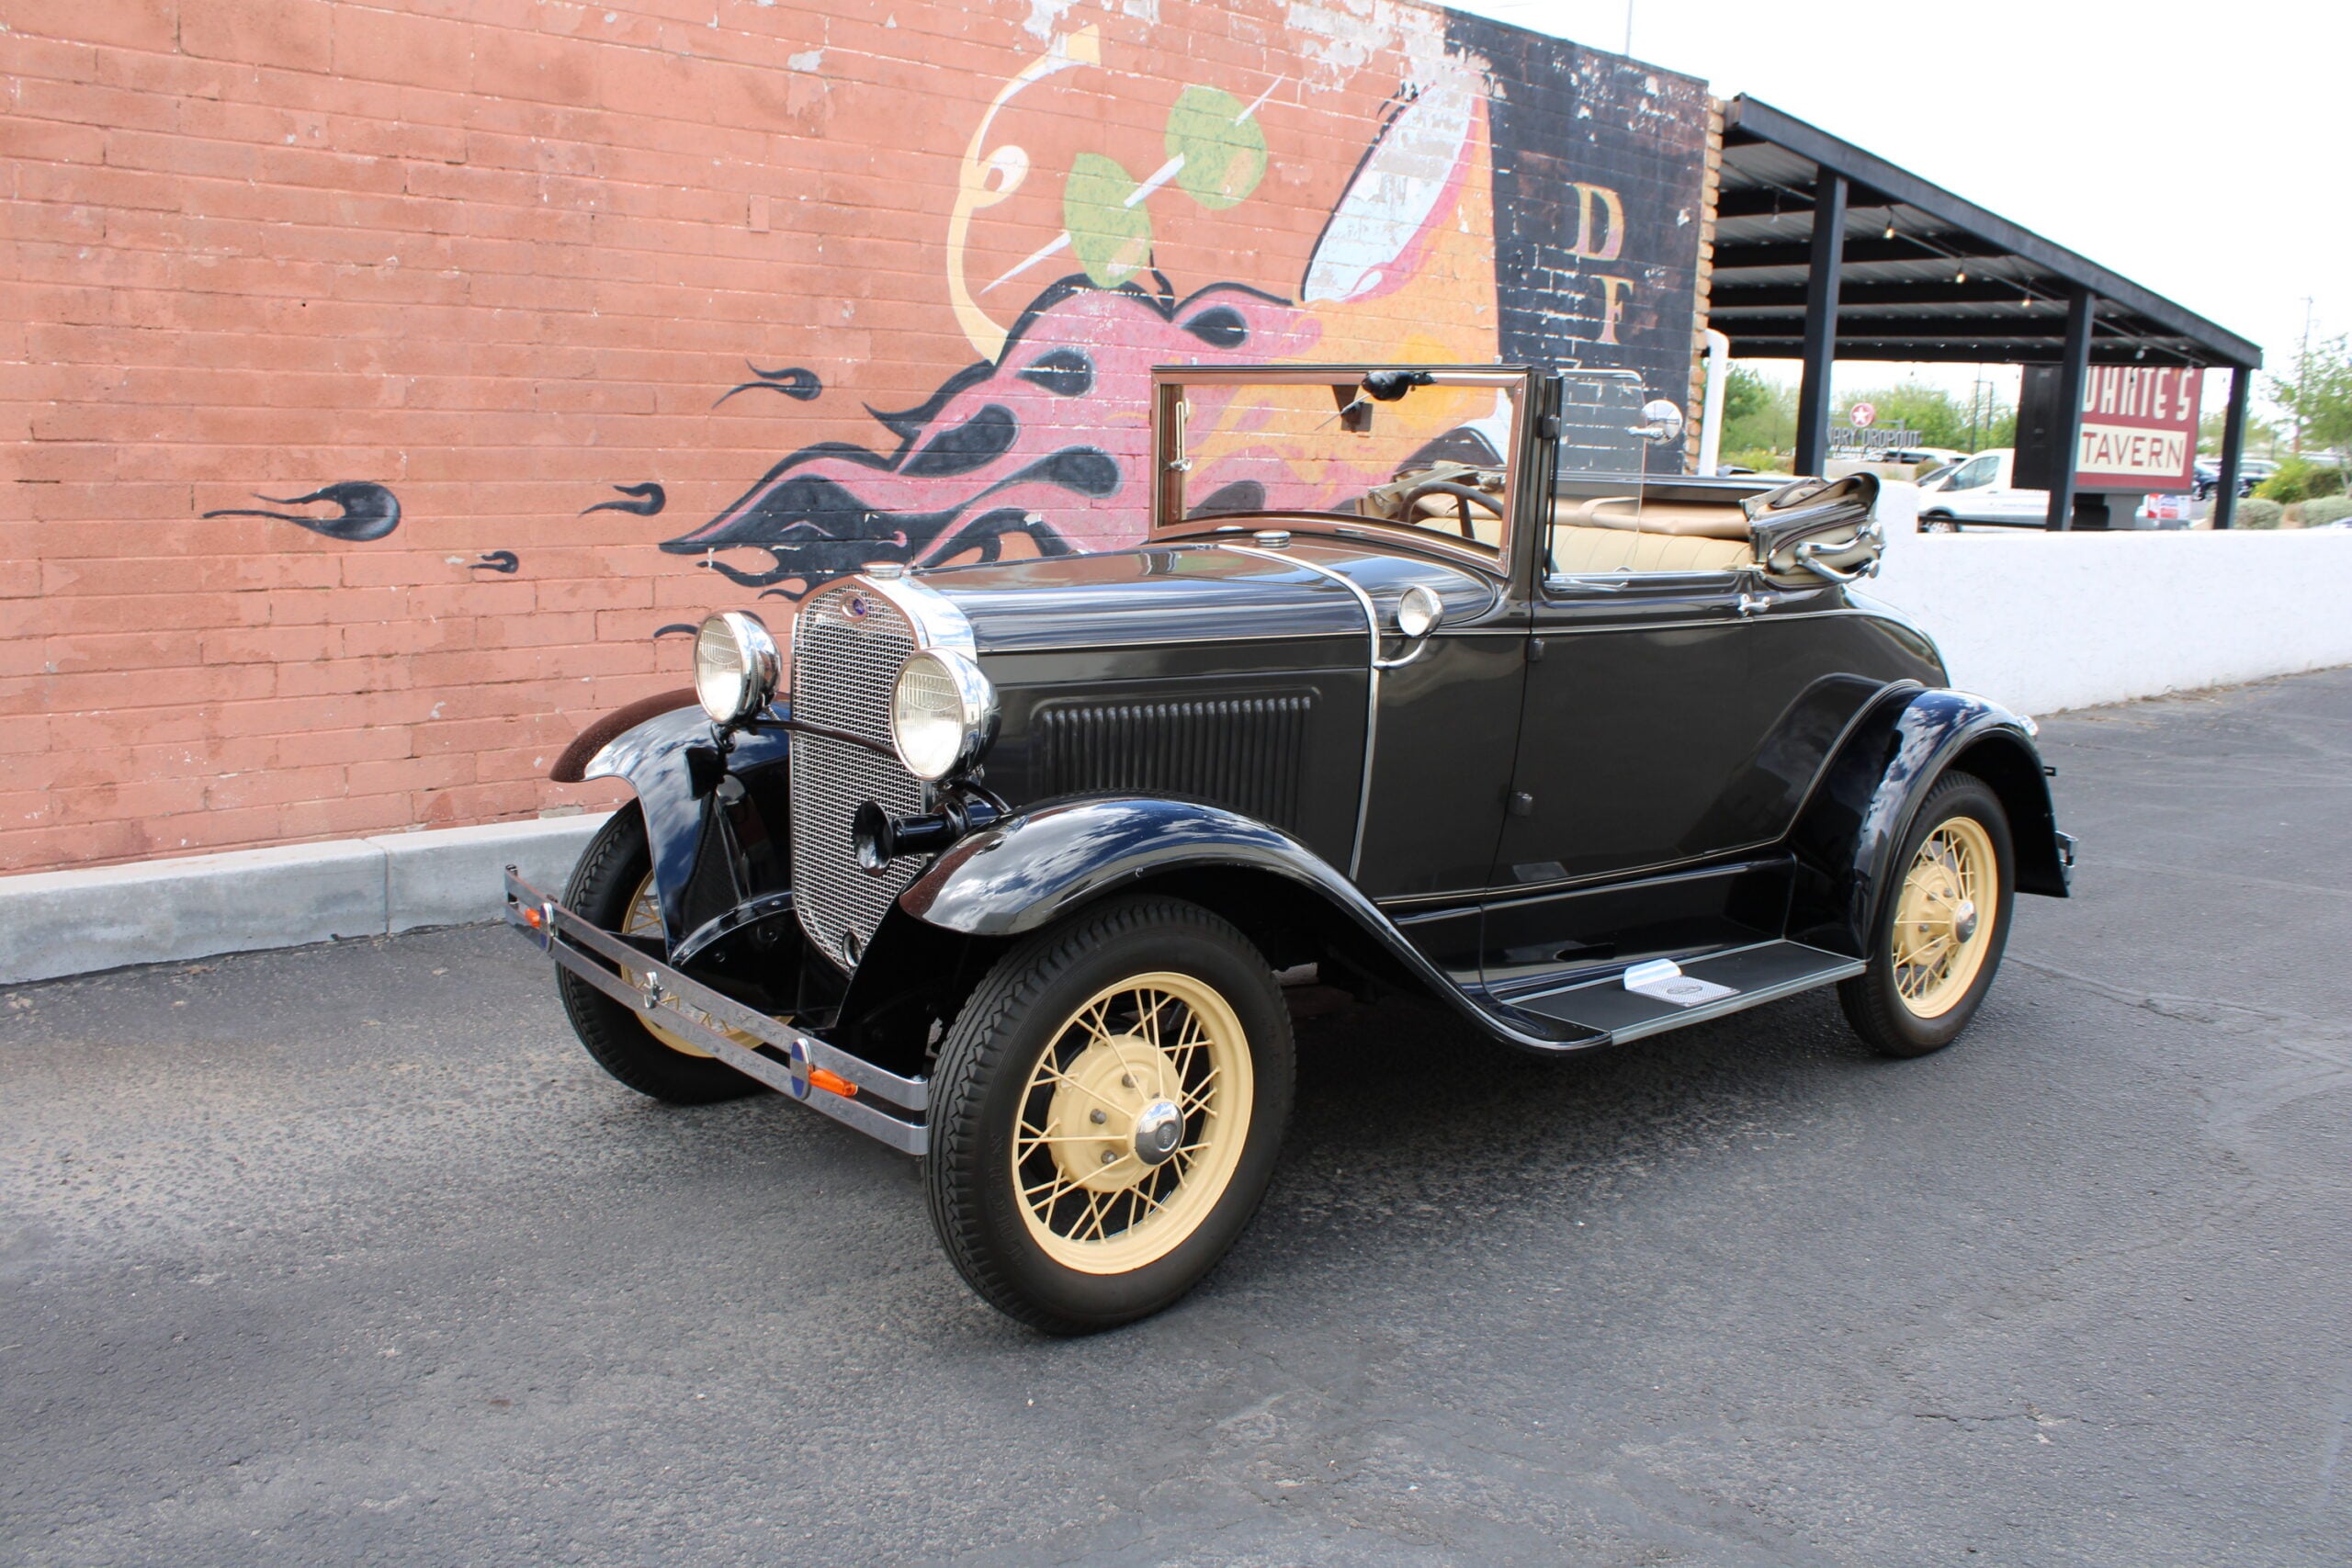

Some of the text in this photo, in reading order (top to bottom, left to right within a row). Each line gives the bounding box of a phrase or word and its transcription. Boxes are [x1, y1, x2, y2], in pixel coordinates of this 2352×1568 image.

[1564, 183, 1625, 261] D
[1591, 276, 1634, 345] F
[1862, 428, 1922, 448] DROPOUT
[2082, 432, 2183, 468] TAVERN
